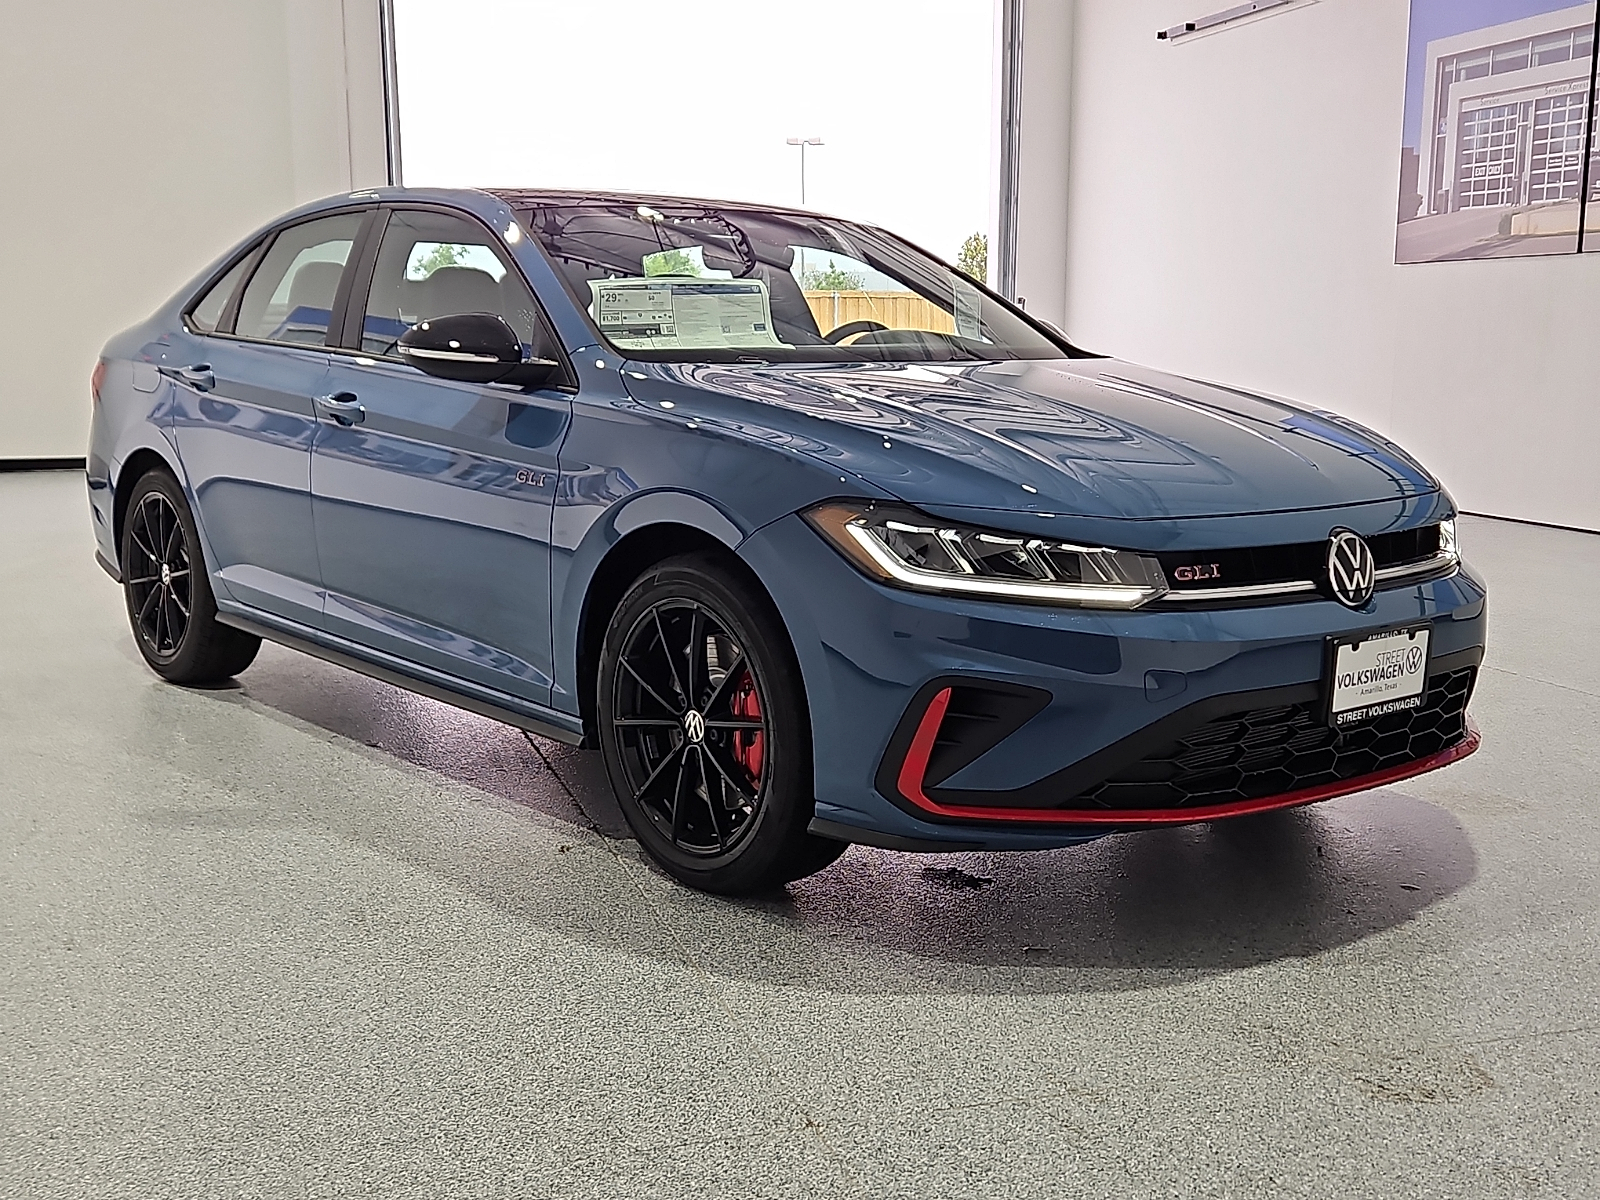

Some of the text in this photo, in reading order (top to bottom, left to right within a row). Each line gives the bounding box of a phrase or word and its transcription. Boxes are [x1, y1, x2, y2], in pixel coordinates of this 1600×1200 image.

[1544, 80, 1588, 95] Service Xpress
[1480, 96, 1500, 106] Service
[1475, 166, 1485, 176] EXIT
[605, 293, 617, 303] 29
[515, 469, 546, 487] GLI
[1174, 563, 1221, 581] GLI
[1375, 648, 1406, 667] STREET
[1337, 662, 1405, 690] VOLKSWAGEN
[1336, 696, 1421, 725] STREET VOLKSWAGEN
